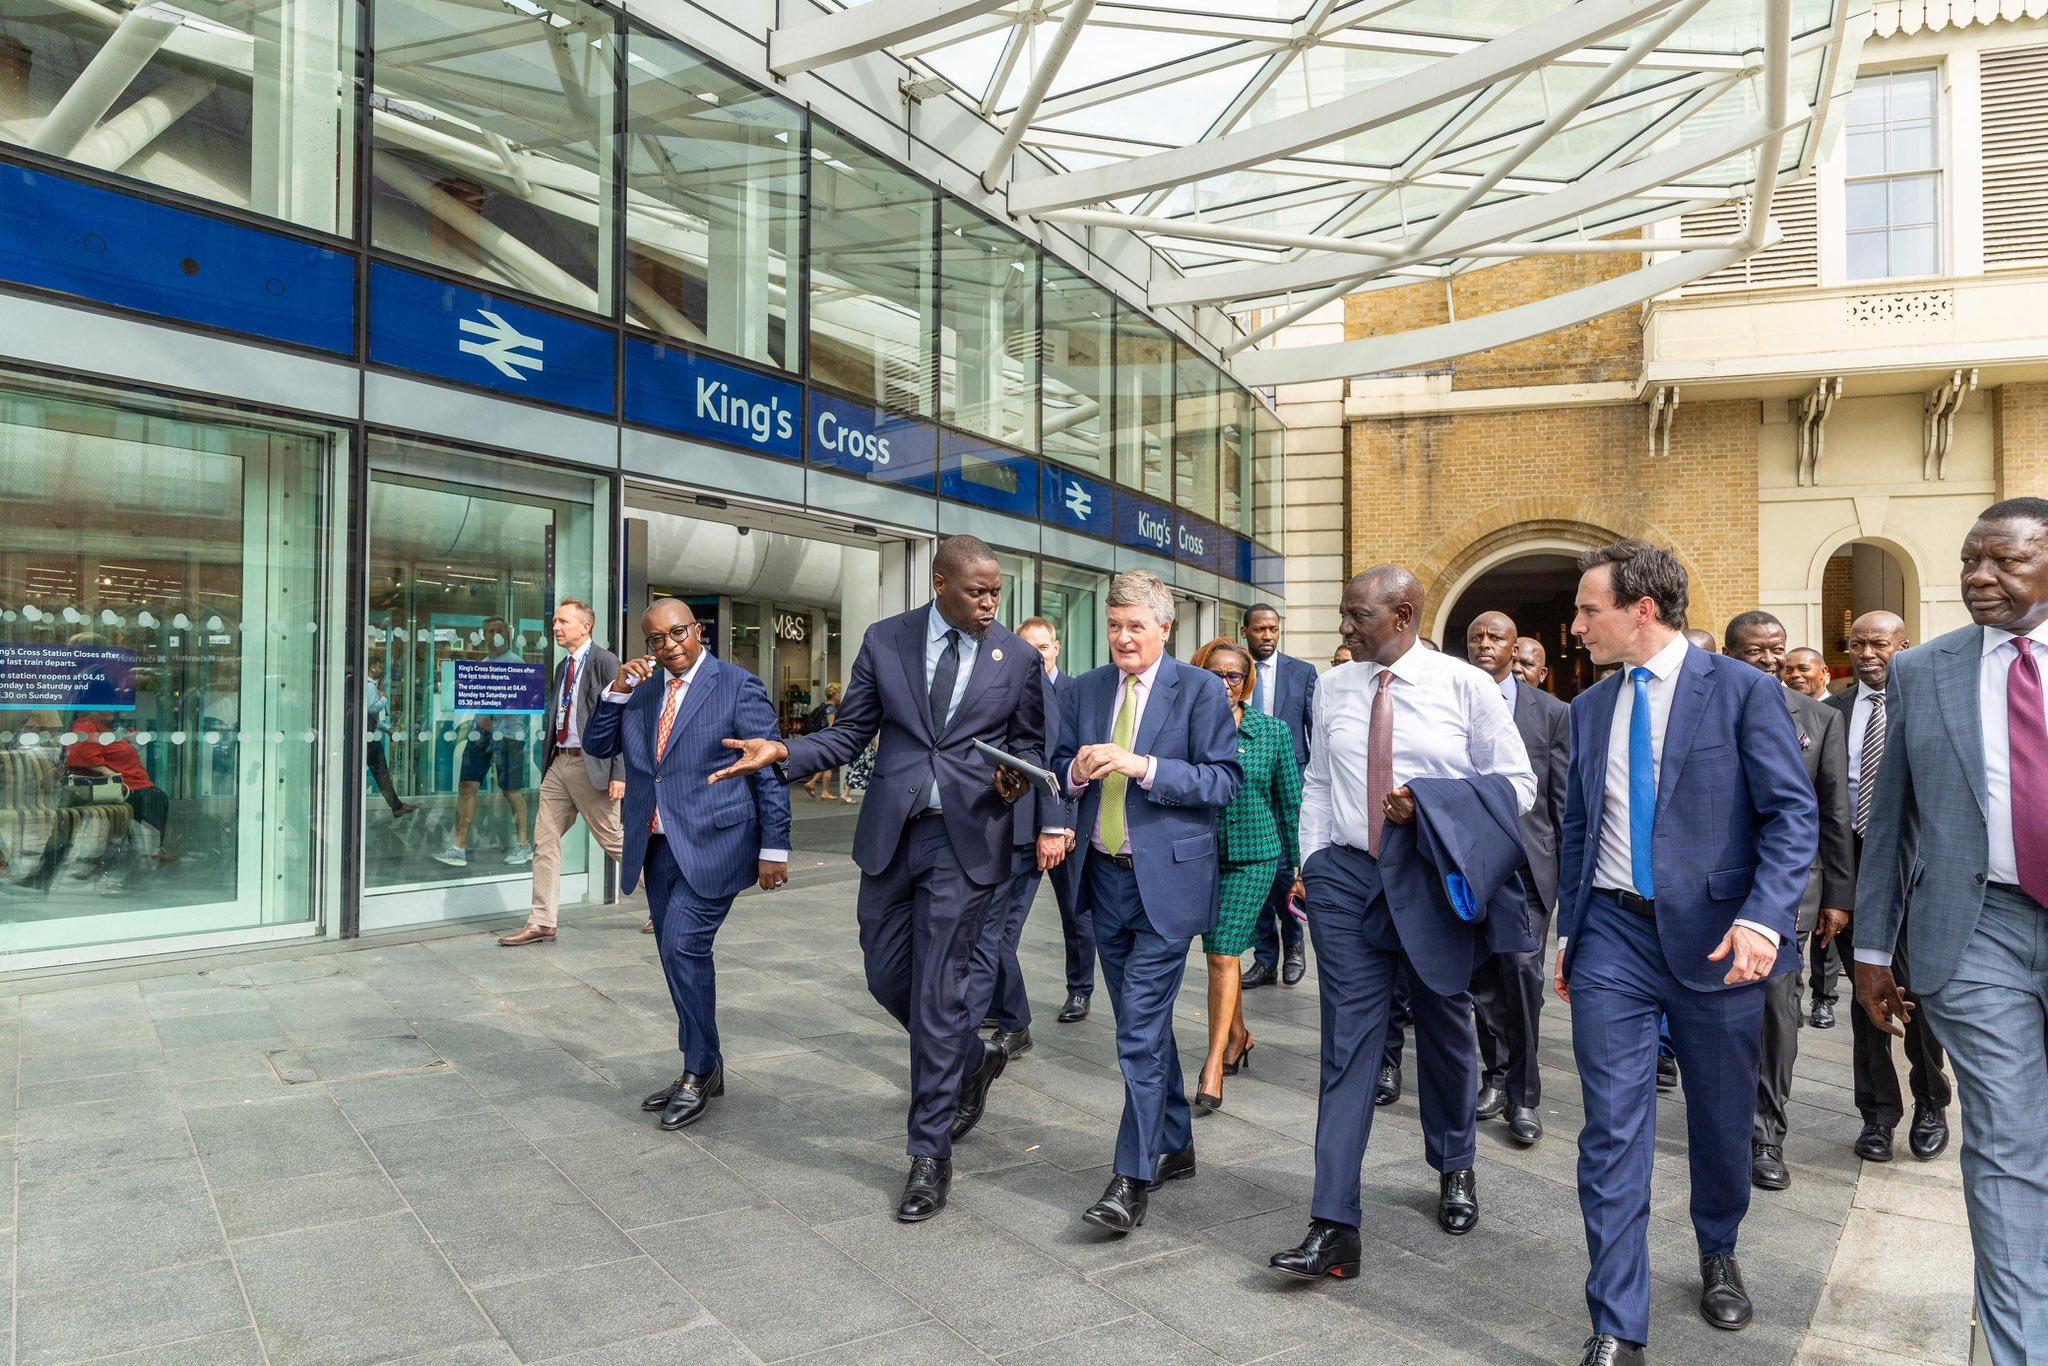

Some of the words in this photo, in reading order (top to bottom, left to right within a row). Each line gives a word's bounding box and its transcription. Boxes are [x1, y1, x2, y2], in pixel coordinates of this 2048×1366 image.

[697, 376, 793, 443] King's
[817, 411, 891, 465] Cross
[1138, 510, 1171, 548] King's
[1178, 525, 1203, 556] Cross
[772, 614, 804, 641] M&S
[17, 648, 41, 656] Cross
[42, 649, 72, 657] Station
[73, 650, 100, 658] Closes
[100, 651, 120, 659] after
[7, 657, 22, 665] last
[45, 659, 78, 667] departs.
[459, 664, 474, 673] King's
[474, 665, 489, 673] Cross
[489, 665, 507, 673] Station
[7, 672, 37, 680] station
[82, 673, 106, 681] 04.45
[25, 682, 35, 690] to
[36, 681, 73, 691] Saturday
[29, 691, 63, 701] Sundays
[458, 691, 479, 699] Monday
[486, 692, 508, 700] Saturday
[481, 699, 502, 707] Sundays
